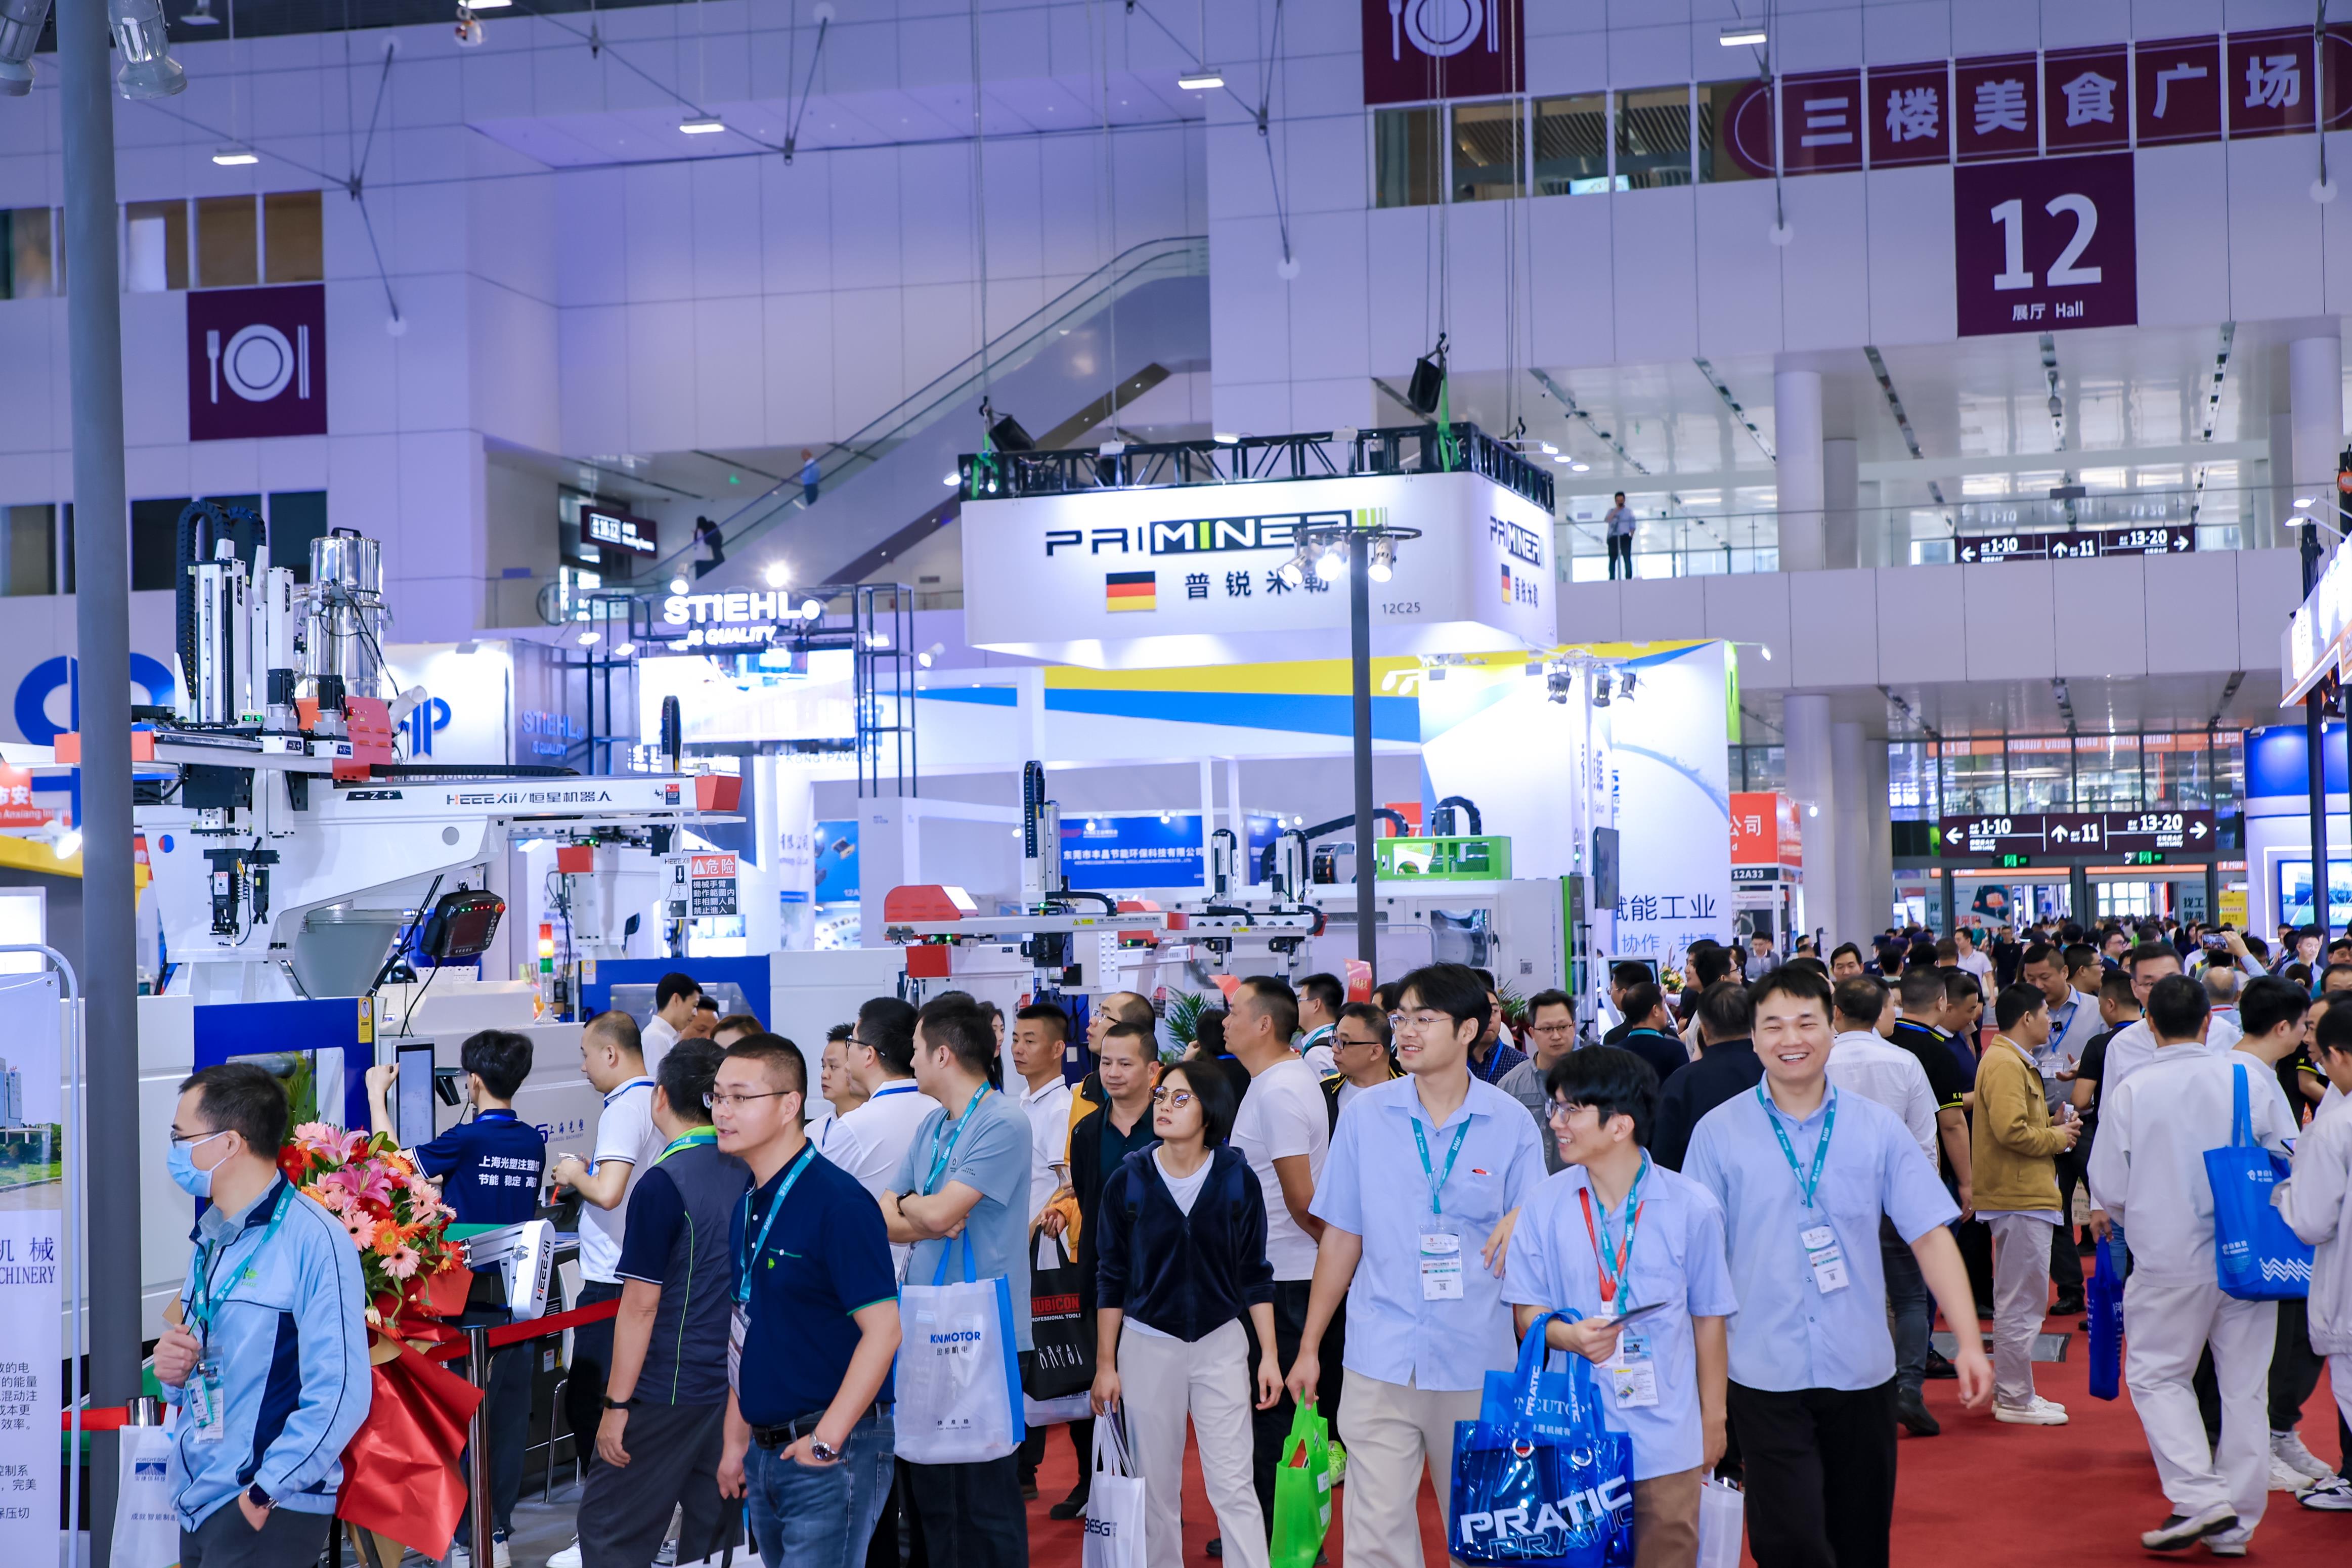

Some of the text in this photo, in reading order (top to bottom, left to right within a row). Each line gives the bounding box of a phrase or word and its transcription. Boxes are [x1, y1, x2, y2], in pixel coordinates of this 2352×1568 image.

[1801, 54, 2301, 148] 三楼美食广场
[1990, 193, 2102, 291] 12
[2012, 301, 2084, 321] 展厅 Hall
[1991, 537, 2018, 552] 1-10
[2130, 529, 2167, 545] 13-20
[2079, 540, 2095, 556] 11
[1382, 601, 1420, 614] 12C25
[706, 626, 776, 645] QUALITY
[827, 752, 881, 762] PAVION
[529, 791, 612, 803] 恒星机器人
[1729, 814, 1762, 837] 公司
[1981, 818, 2012, 835] 1-10
[2140, 813, 2183, 831] 13-20
[2081, 823, 2099, 842] 11
[706, 858, 734, 875] 危险
[1733, 869, 1764, 879] 12A33
[693, 880, 726, 888] 機械手臂
[693, 897, 735, 906] 非相關人員
[693, 906, 727, 915] 禁止進入
[1622, 933, 1660, 953] 协作
[1453, 1136, 1461, 1152] DMP
[478, 1173, 499, 1186] 节能
[504, 1175, 521, 1187] 稳定
[764, 1214, 773, 1231] DMP
[0, 1266, 55, 1284] CHINERY
[0, 1376, 37, 1388] 的能量
[0, 1390, 37, 1402] 混动注
[1526, 1365, 1541, 1416] PRATIC
[1460, 1474, 1632, 1543] PRATIC
[130, 1513, 179, 1521] 成就智能制造
